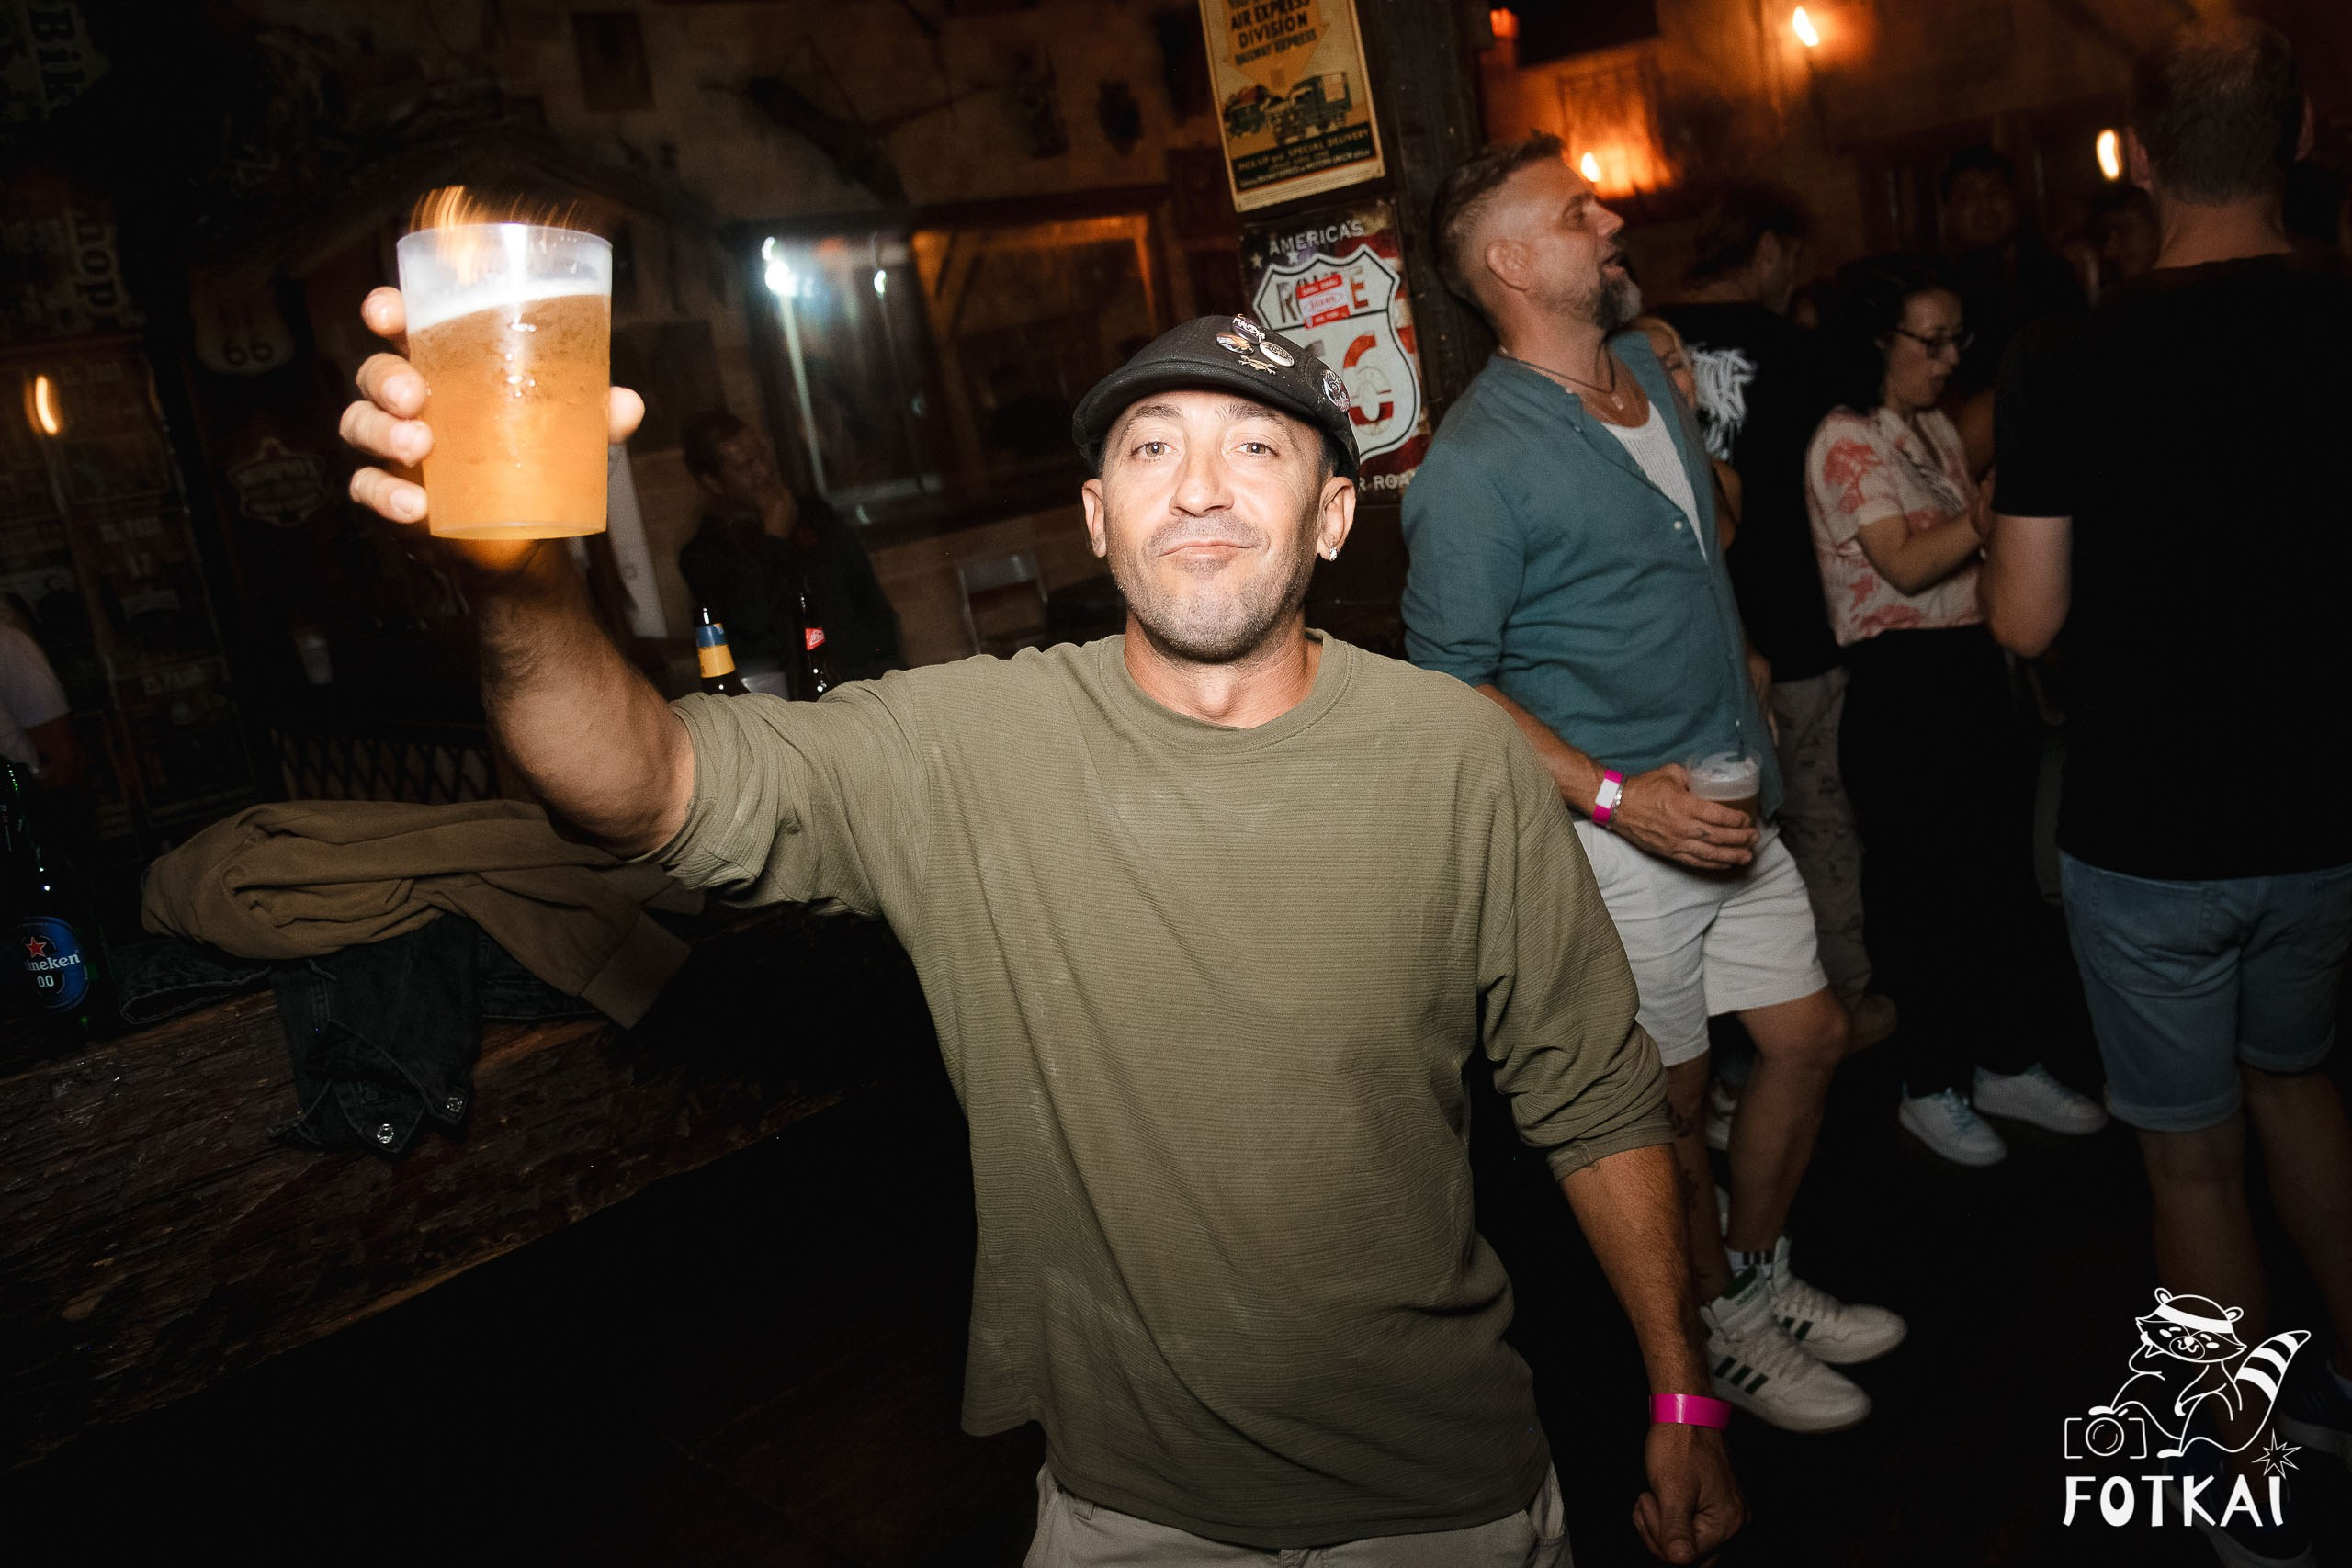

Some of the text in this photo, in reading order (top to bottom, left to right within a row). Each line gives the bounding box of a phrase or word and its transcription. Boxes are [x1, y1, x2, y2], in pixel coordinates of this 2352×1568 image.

[1238, 12, 1308, 48] DIVISION
[1269, 219, 1365, 257] AMERICA'S
[23, 953, 81, 971] ineken
